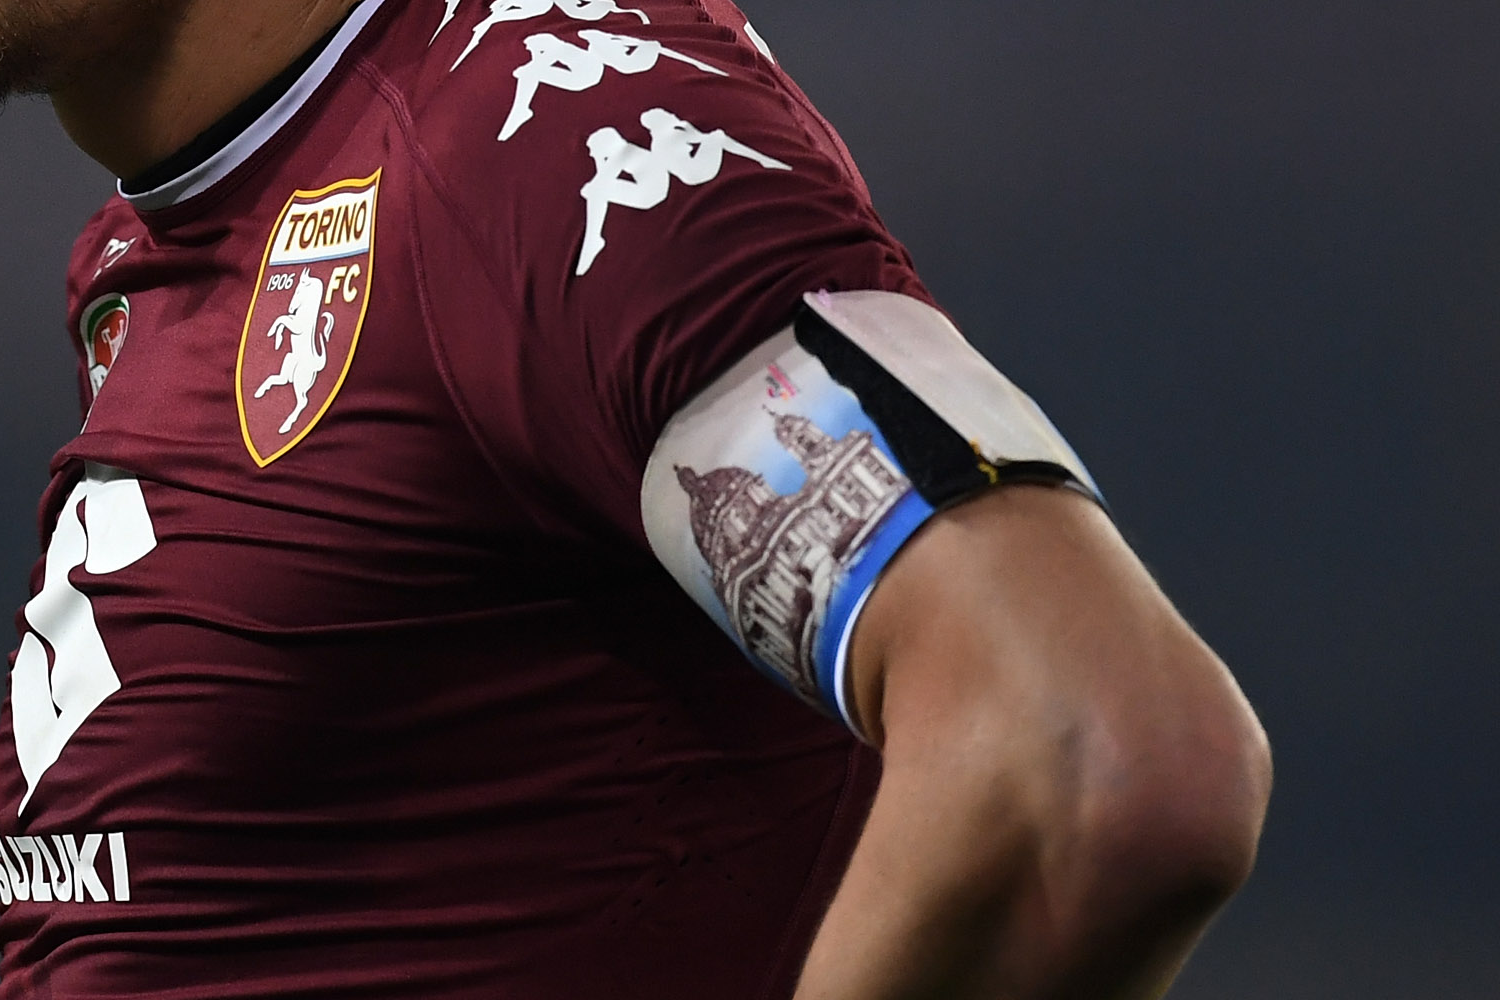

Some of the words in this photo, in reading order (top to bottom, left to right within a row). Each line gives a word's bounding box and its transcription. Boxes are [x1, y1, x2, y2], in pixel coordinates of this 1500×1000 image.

[284, 200, 367, 252] TORINO
[266, 273, 296, 292] 1906
[324, 263, 361, 305] FC
